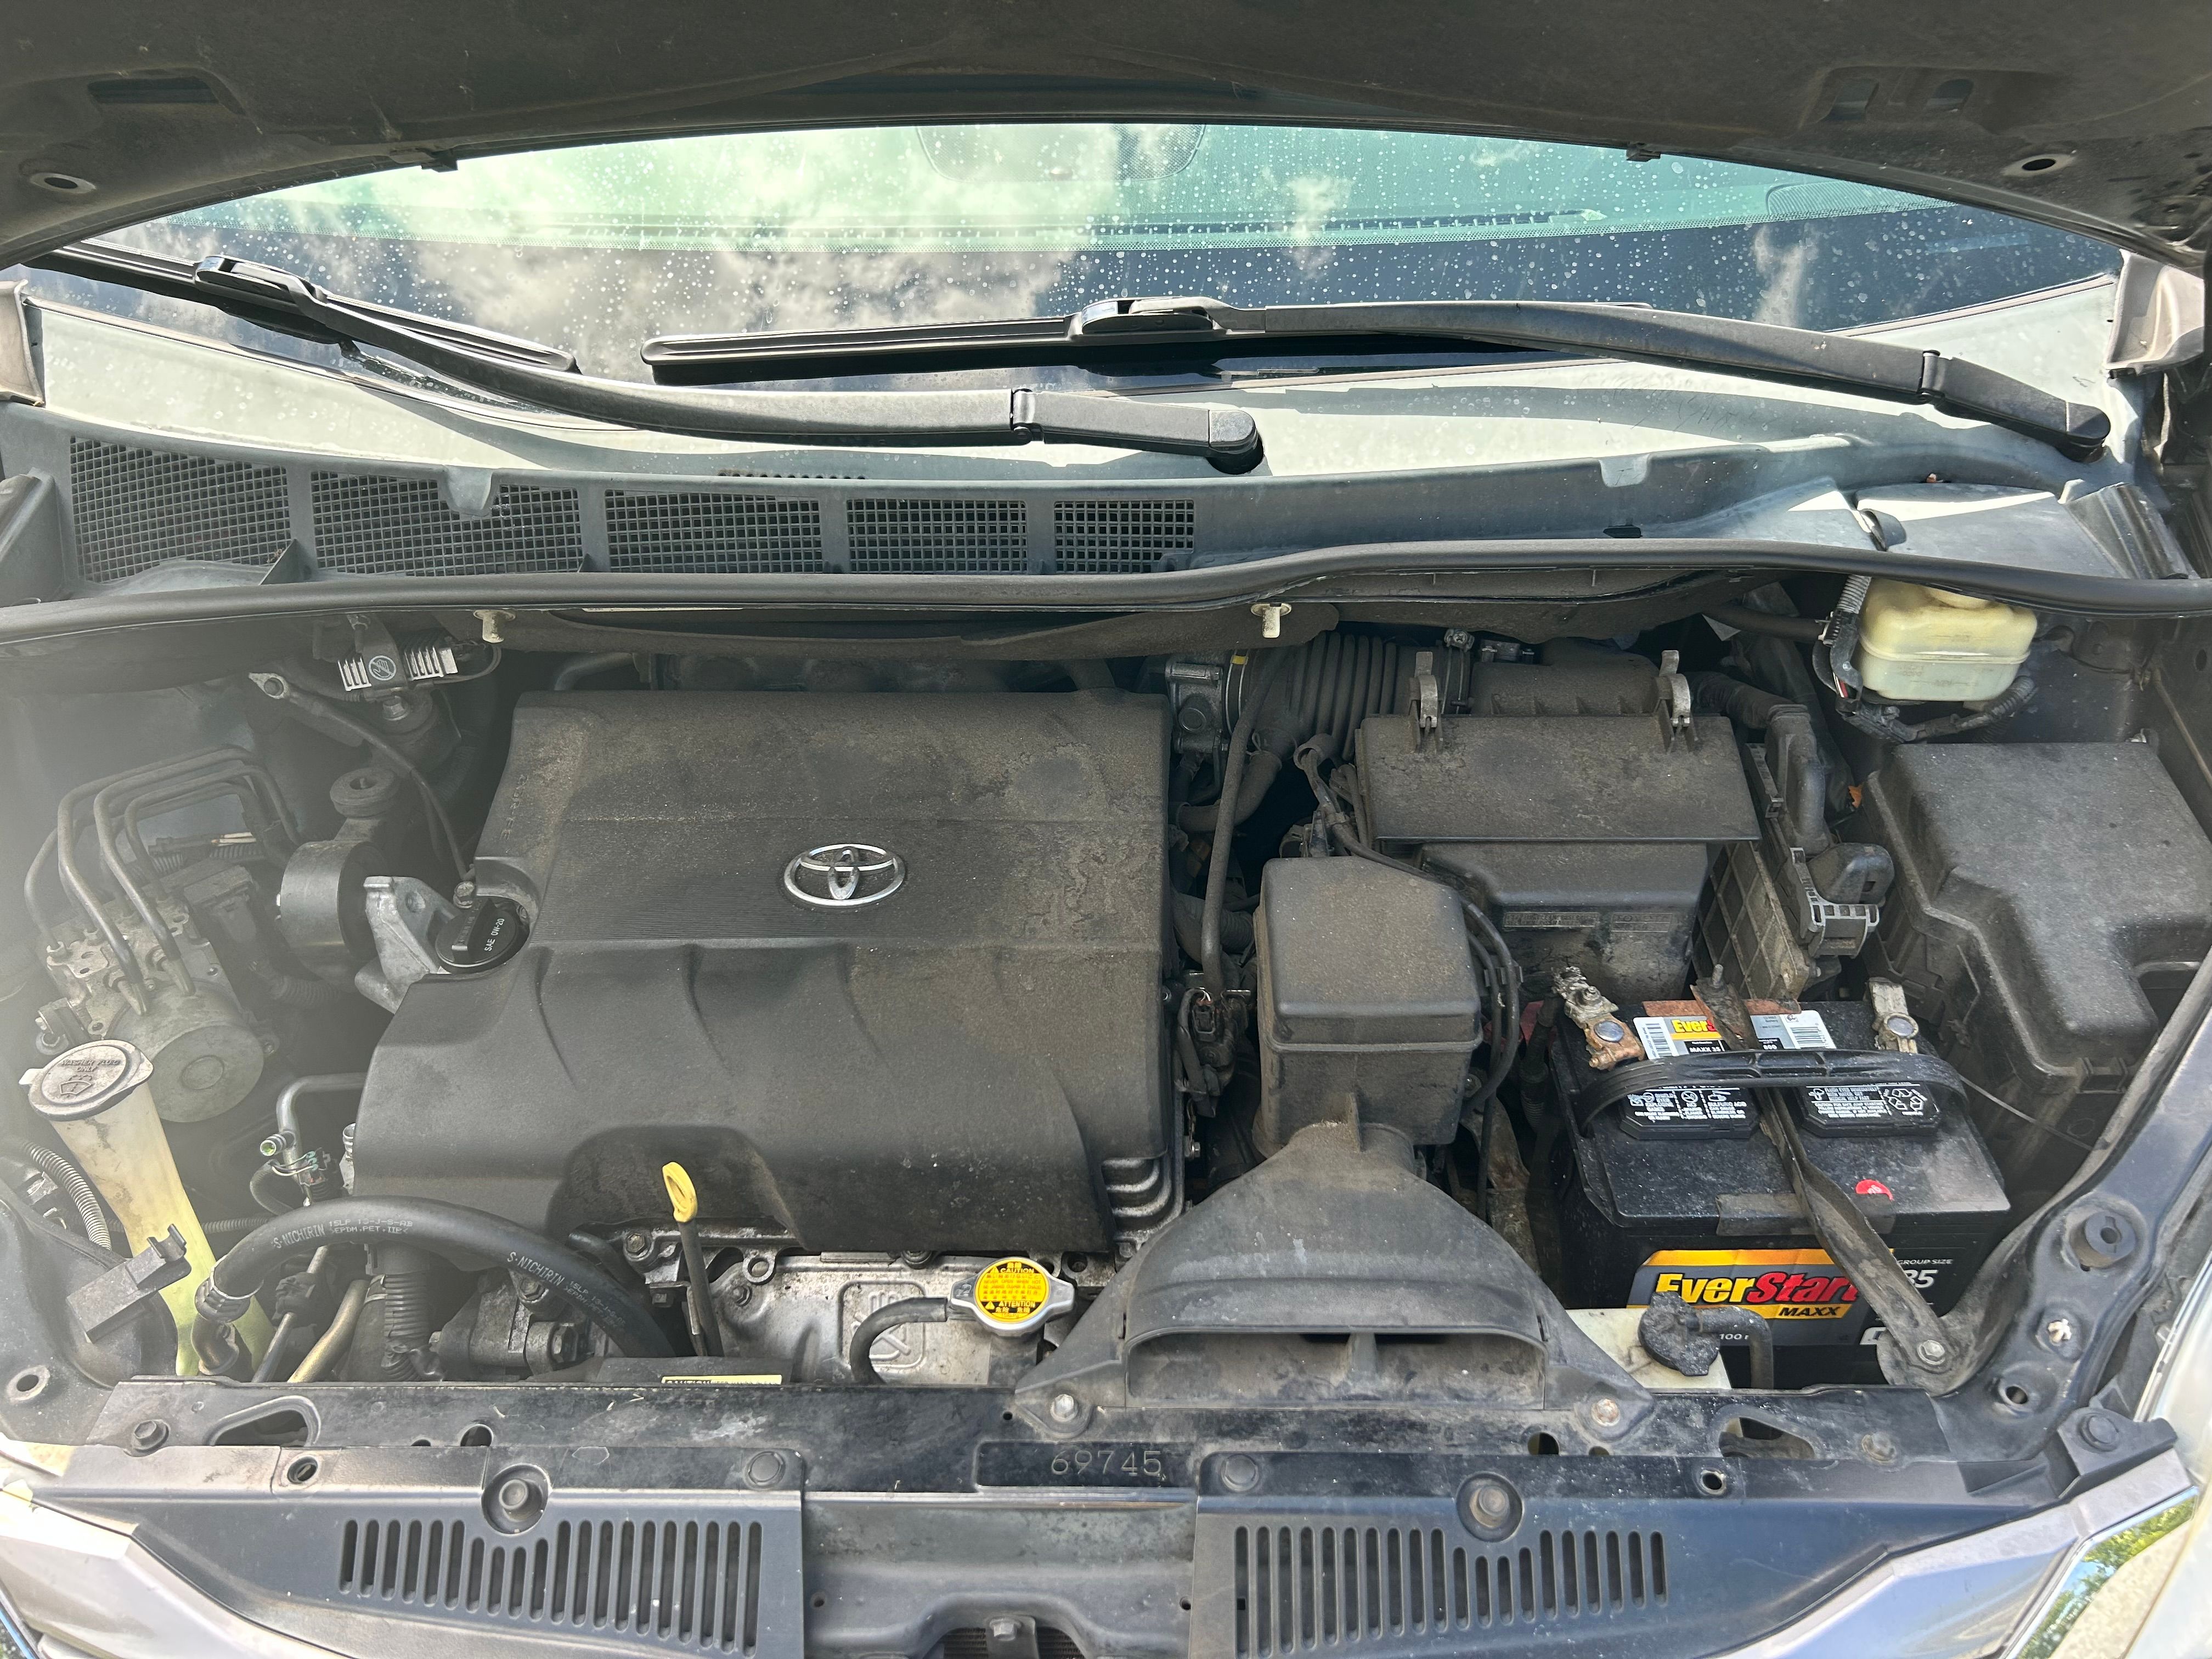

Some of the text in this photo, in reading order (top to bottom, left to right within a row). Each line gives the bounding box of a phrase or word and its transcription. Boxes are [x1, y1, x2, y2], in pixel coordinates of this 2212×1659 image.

[484, 918, 505, 952] SAE 0W-20
[1778, 1306, 1841, 1317] MAXX
[1051, 1450, 1161, 1476] 69745
